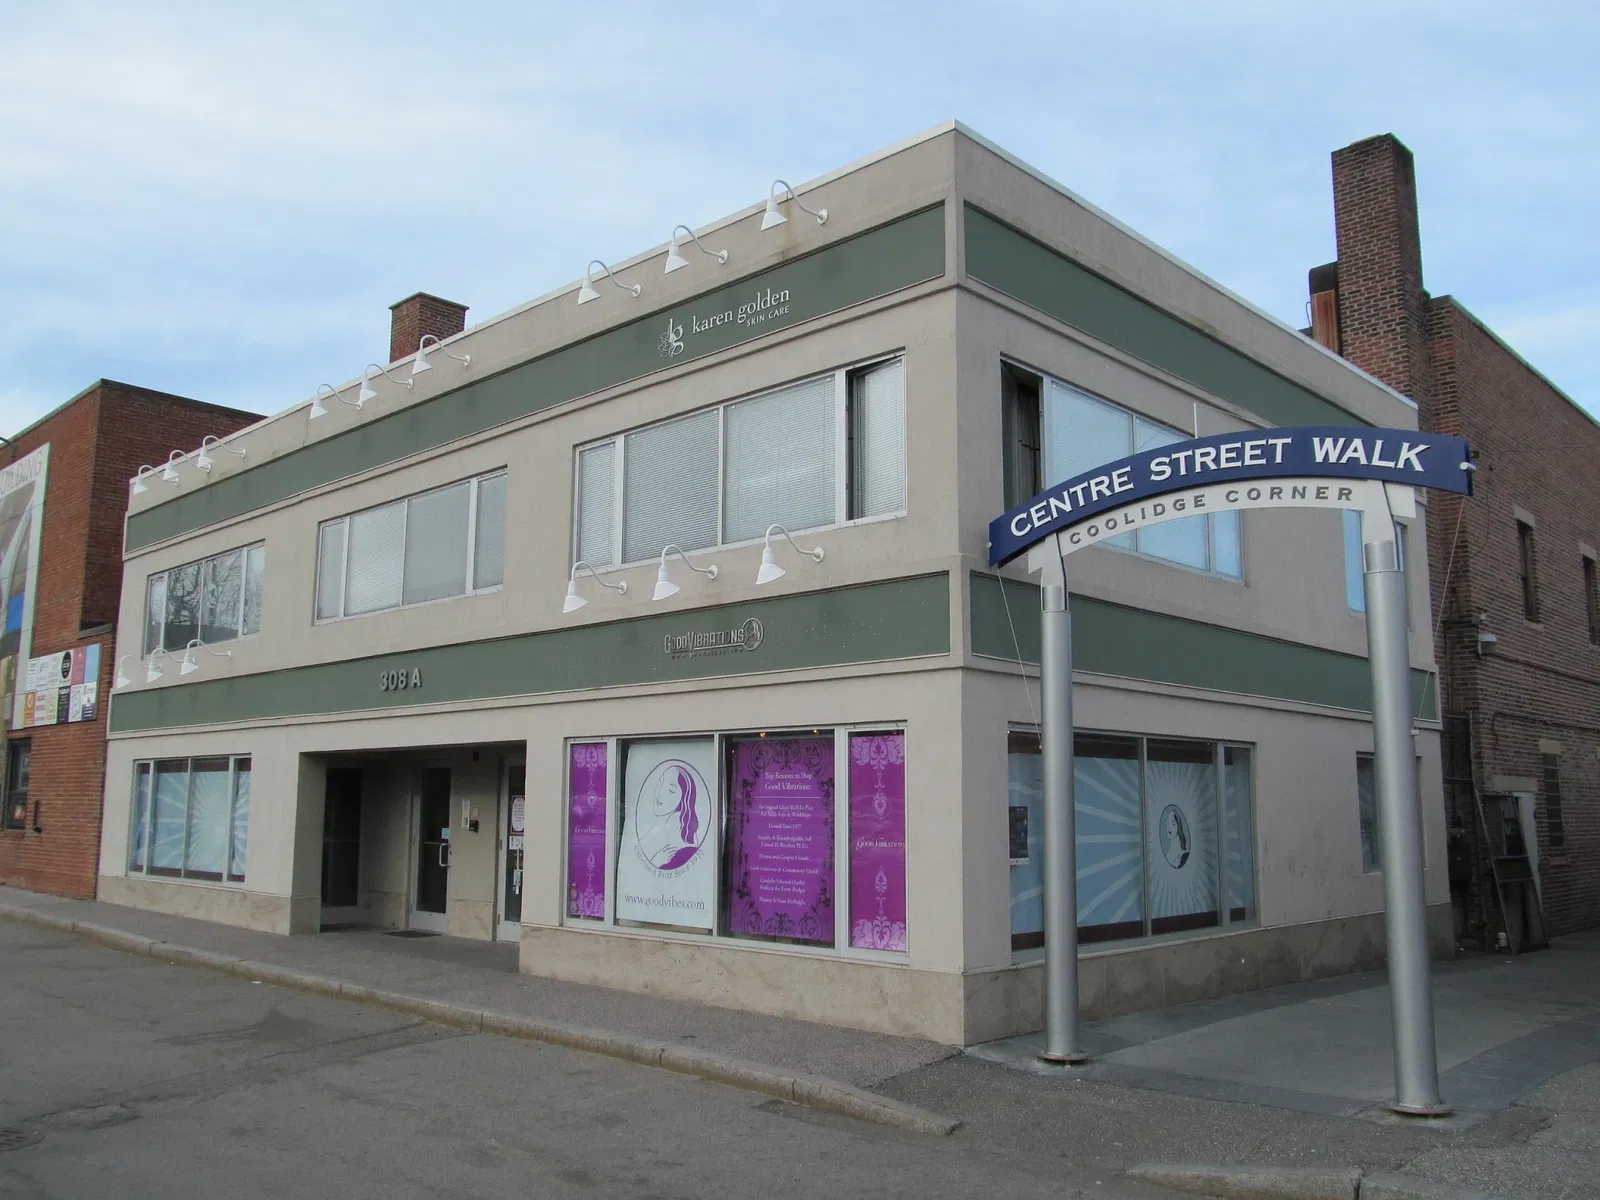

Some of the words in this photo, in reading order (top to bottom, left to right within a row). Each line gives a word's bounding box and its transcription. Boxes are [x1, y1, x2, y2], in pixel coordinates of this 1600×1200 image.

[691, 310, 733, 334] karen
[737, 288, 790, 323] golden
[746, 313, 765, 328] SKIN
[768, 305, 790, 319] CARE
[1010, 465, 1135, 537] CENTRE
[1150, 437, 1292, 480] STREET
[1312, 437, 1431, 472] WALK
[1069, 493, 1206, 544] COOLIDGE
[1225, 485, 1353, 503] CORNER
[764, 781, 780, 790] Good
[624, 894, 705, 911] www.goodvibes.com
